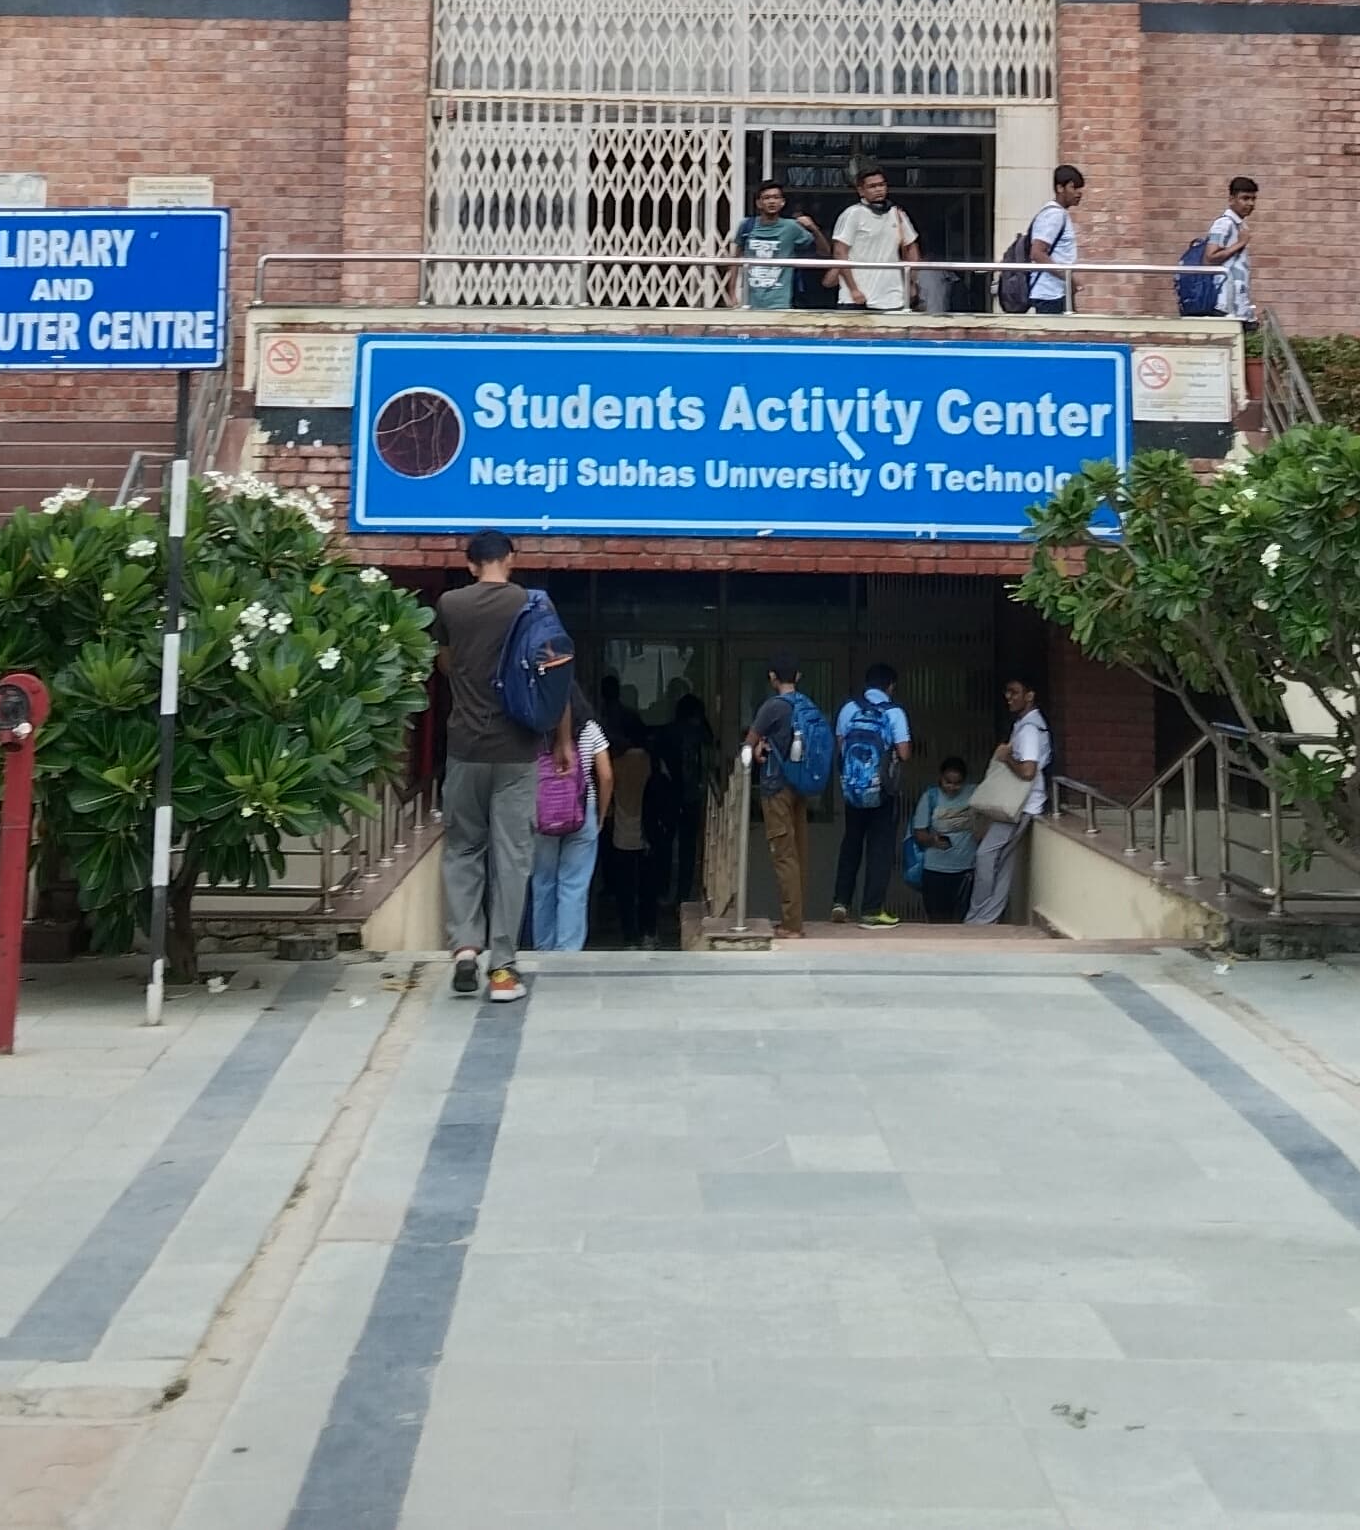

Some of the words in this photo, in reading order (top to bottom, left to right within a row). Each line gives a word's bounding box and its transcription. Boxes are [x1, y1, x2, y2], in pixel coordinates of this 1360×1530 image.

[30, 278, 94, 301] AND
[89, 310, 216, 350] CENTRE
[474, 382, 706, 432] Students
[720, 386, 922, 445] Activity
[937, 389, 1112, 437] Center
[470, 457, 568, 493] Netaji
[577, 458, 695, 488] Subhas
[705, 458, 870, 497] University
[879, 462, 917, 491] Of
[925, 463, 1073, 494] Technolo
